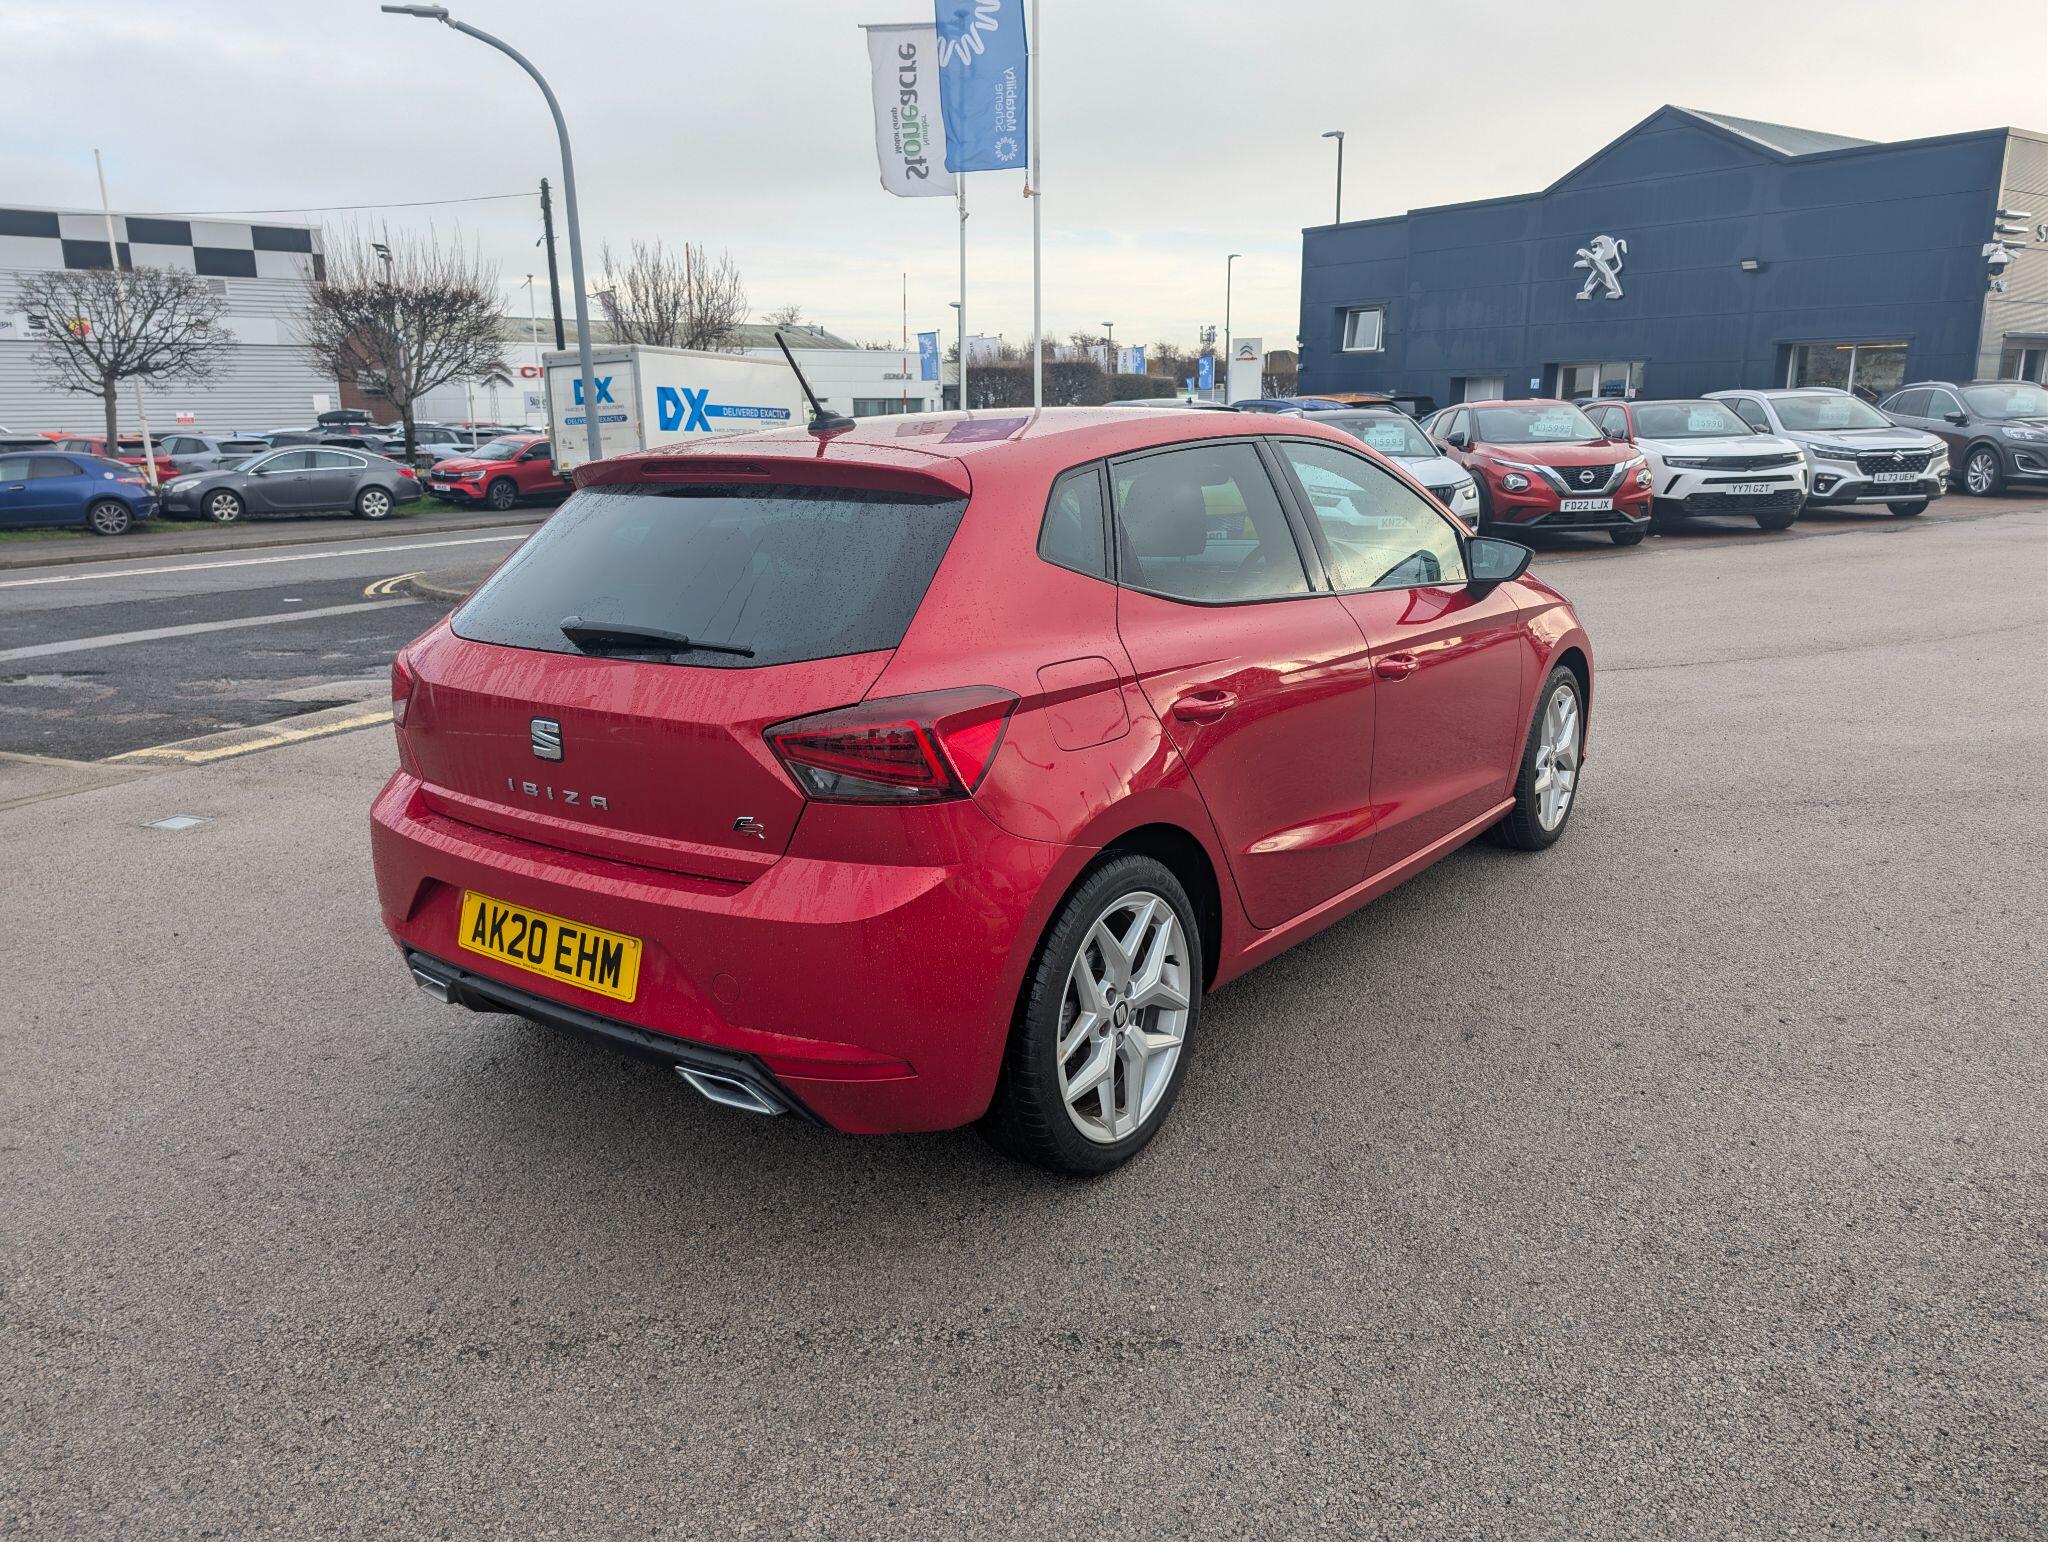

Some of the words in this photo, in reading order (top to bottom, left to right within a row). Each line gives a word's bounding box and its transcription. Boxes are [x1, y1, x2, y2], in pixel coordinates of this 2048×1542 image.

[656, 387, 712, 432] DX
[723, 408, 759, 417] DELIVERED
[760, 409, 788, 419] EXACTLY
[1753, 484, 1770, 492] GZT
[1564, 501, 1589, 510] FD22
[1591, 500, 1609, 509] LJX
[508, 778, 609, 811] IBIZA
[733, 816, 764, 839] FR
[472, 902, 548, 965] AK20
[554, 926, 624, 989] EHM
